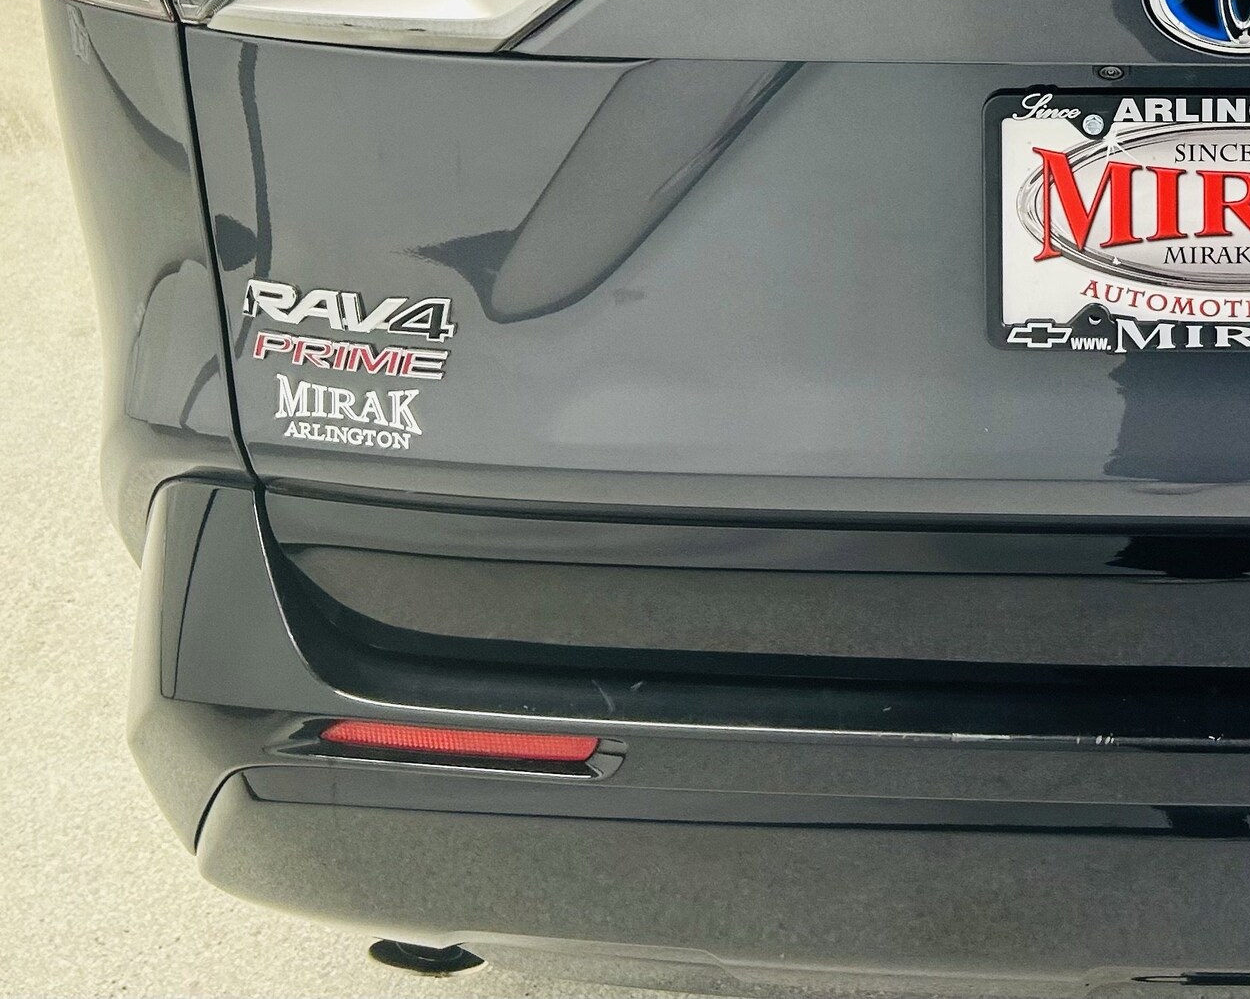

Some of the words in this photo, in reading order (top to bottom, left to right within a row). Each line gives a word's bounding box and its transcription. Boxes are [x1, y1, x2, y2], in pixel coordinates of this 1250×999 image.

[1012, 92, 1081, 121] Since
[242, 279, 456, 342] RAV4
[253, 331, 449, 379] PRIME
[274, 373, 423, 436] MIRAK
[283, 420, 412, 450] ARLINGTON
